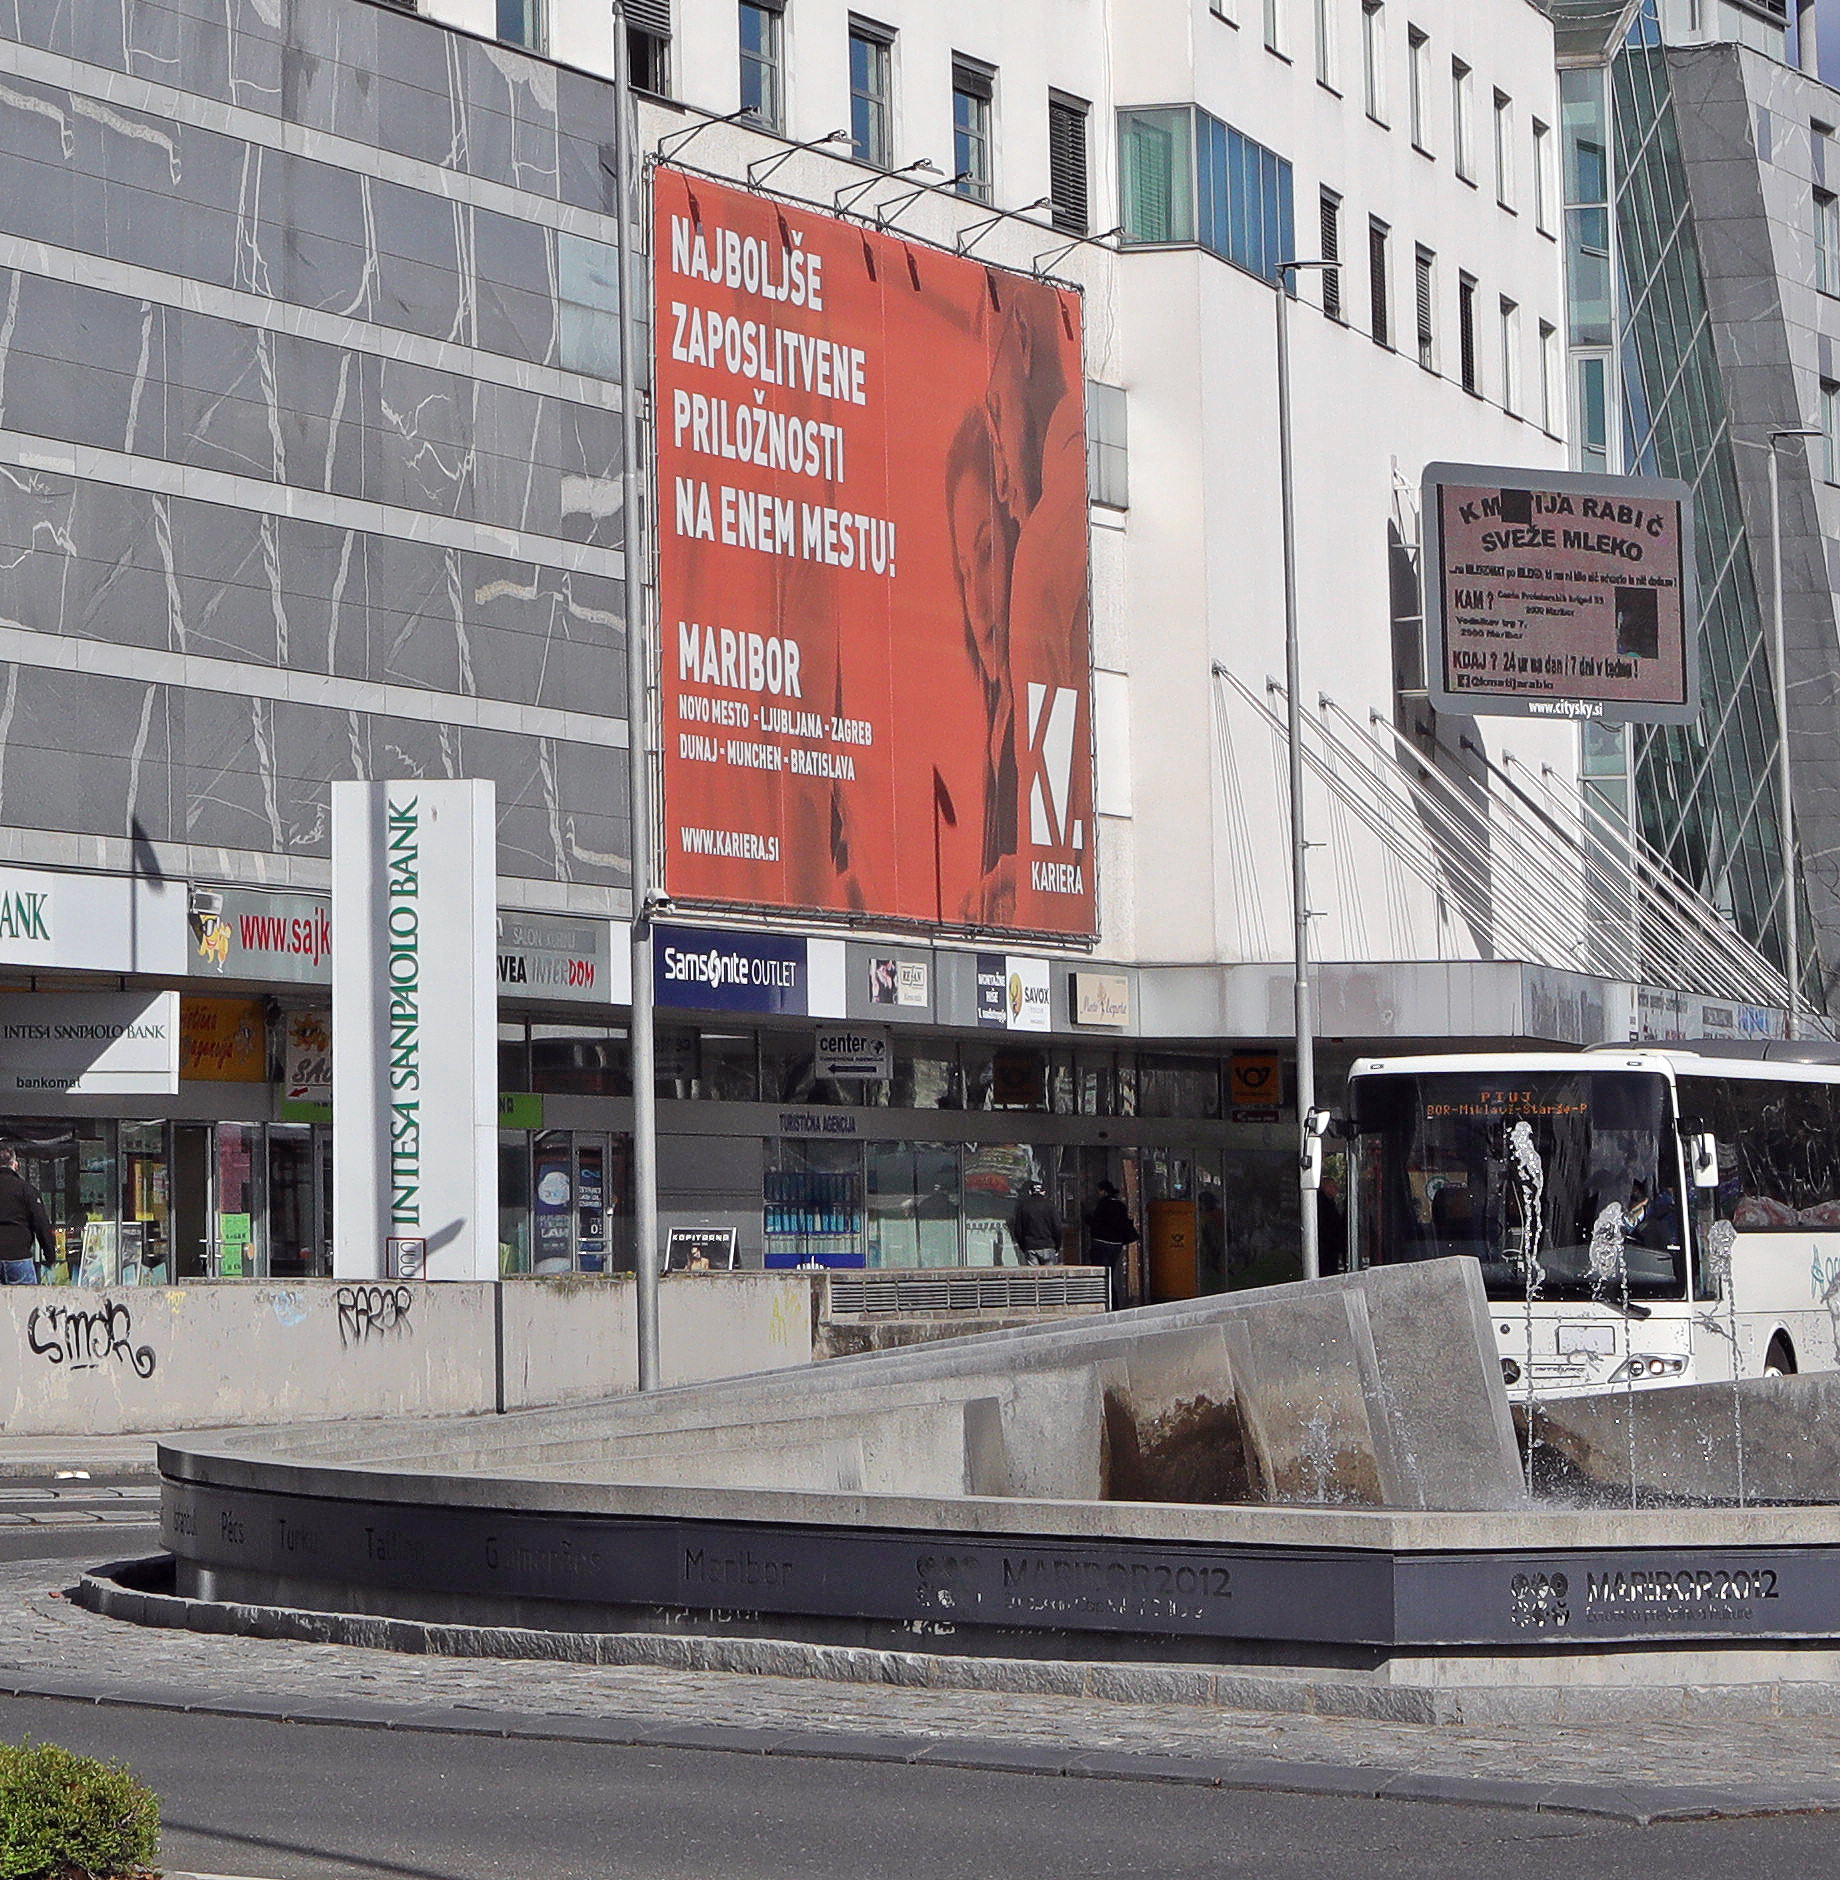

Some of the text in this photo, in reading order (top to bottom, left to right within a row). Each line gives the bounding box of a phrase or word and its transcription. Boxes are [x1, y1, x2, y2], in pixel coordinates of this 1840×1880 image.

[672, 214, 823, 312] NAJBOLJŠE
[672, 301, 866, 406] ZAPOSLITVENE
[674, 388, 844, 483] PRILOŽNOSTI
[676, 476, 896, 578] NA ENEM MESTU!
[1459, 493, 1664, 538] KMIJA RABIČ
[1481, 525, 1643, 561] SVEŽE MLEKO
[678, 621, 801, 698] MARIBOR
[1452, 650, 1487, 670] KDAJ
[679, 694, 873, 746] NOVO MESTO LJUBLJANA ZAGREB
[1528, 699, 1603, 719] www.citysky.si
[679, 733, 856, 781] DUNAJ MUNCHEN BRATISLAVA
[681, 826, 780, 862] WWW.KARIERA.SI
[1031, 861, 1084, 895] KARIERA
[664, 947, 797, 988] Samsonite OUTLET
[387, 793, 421, 1228] INTESA SANPAOLO BANK
[1025, 986, 1049, 1004] SAVOX
[3, 1024, 166, 1040] INTESA SANPAOLO BANK
[820, 1033, 867, 1053] center
[16, 1076, 81, 1090] bankomat
